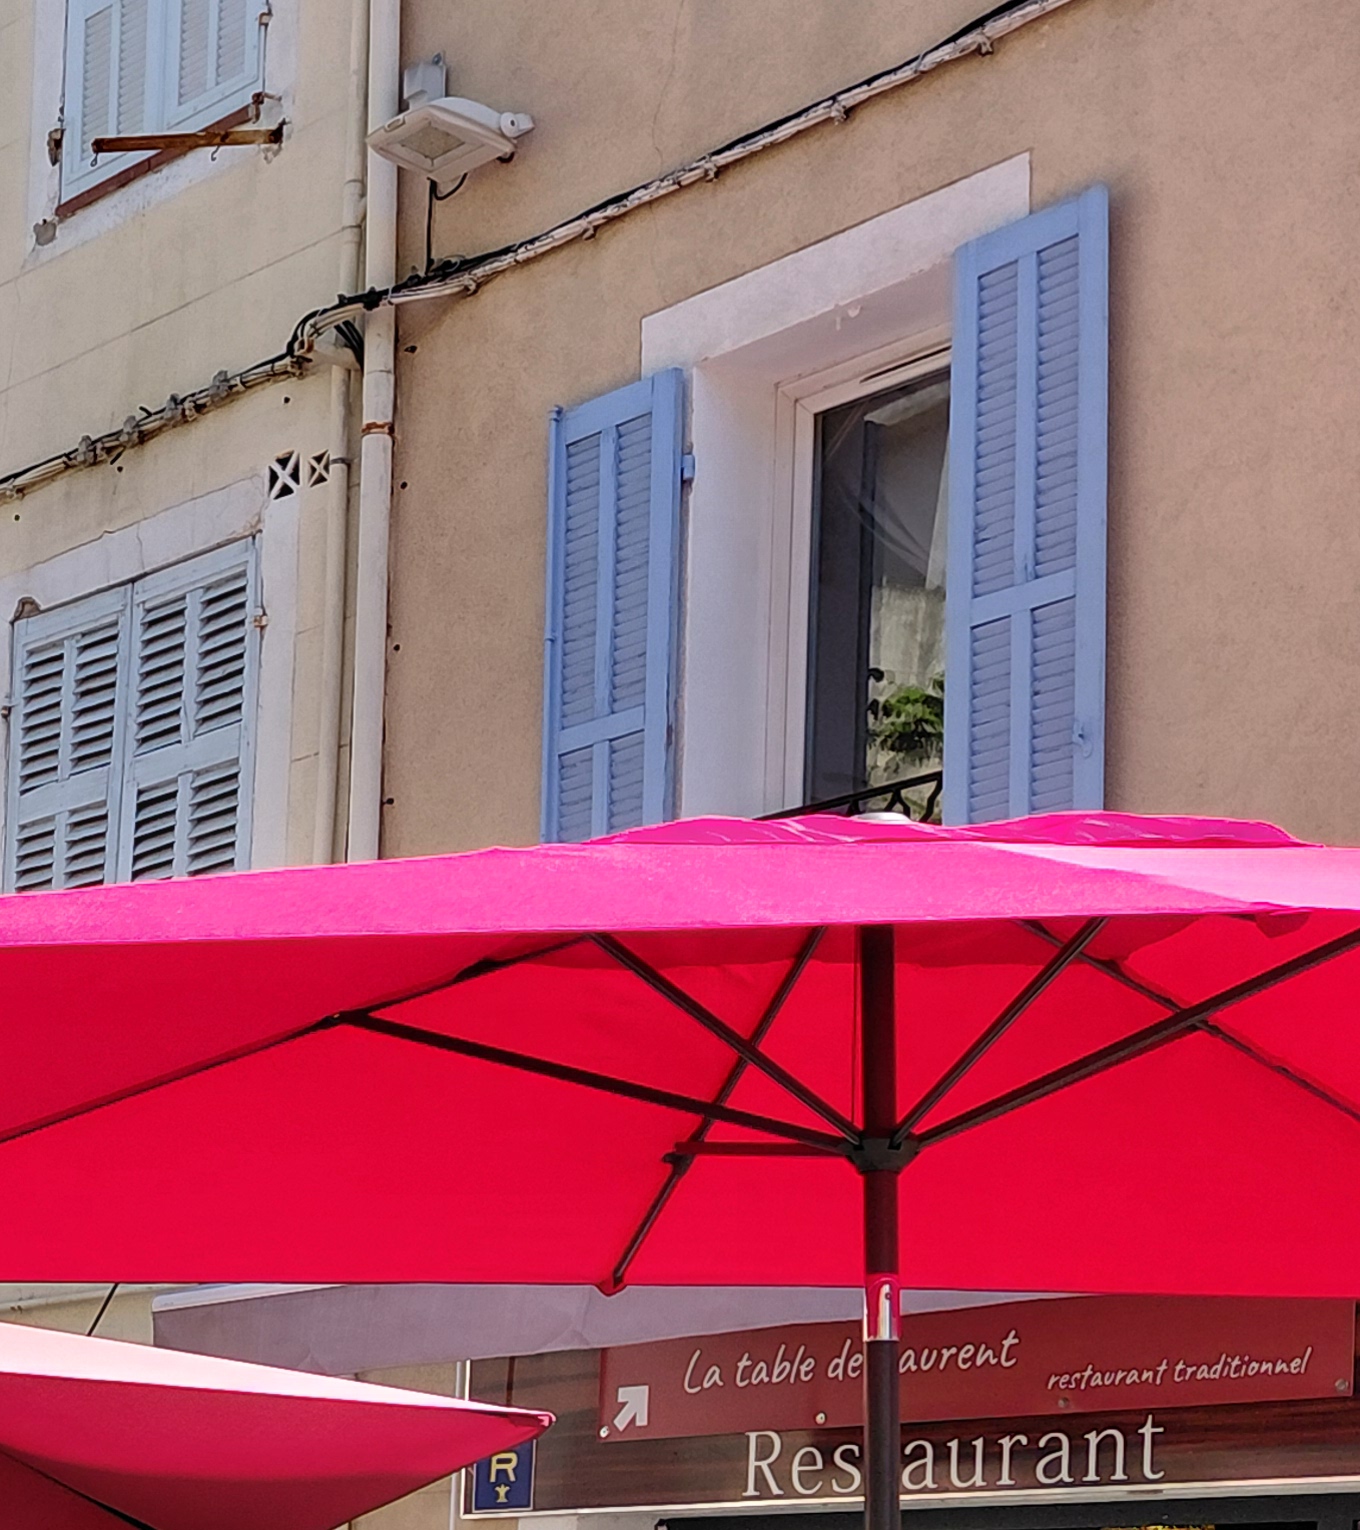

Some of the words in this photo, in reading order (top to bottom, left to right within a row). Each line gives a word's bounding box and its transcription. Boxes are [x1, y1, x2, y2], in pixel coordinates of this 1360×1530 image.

[683, 1349, 724, 1394] La
[735, 1344, 816, 1388] table
[827, 1338, 863, 1381] de
[897, 1329, 1020, 1376] aurent
[1046, 1358, 1168, 1390] restaurant
[1173, 1345, 1313, 1383] traditionnel
[741, 1413, 1166, 1498] Resaurant
